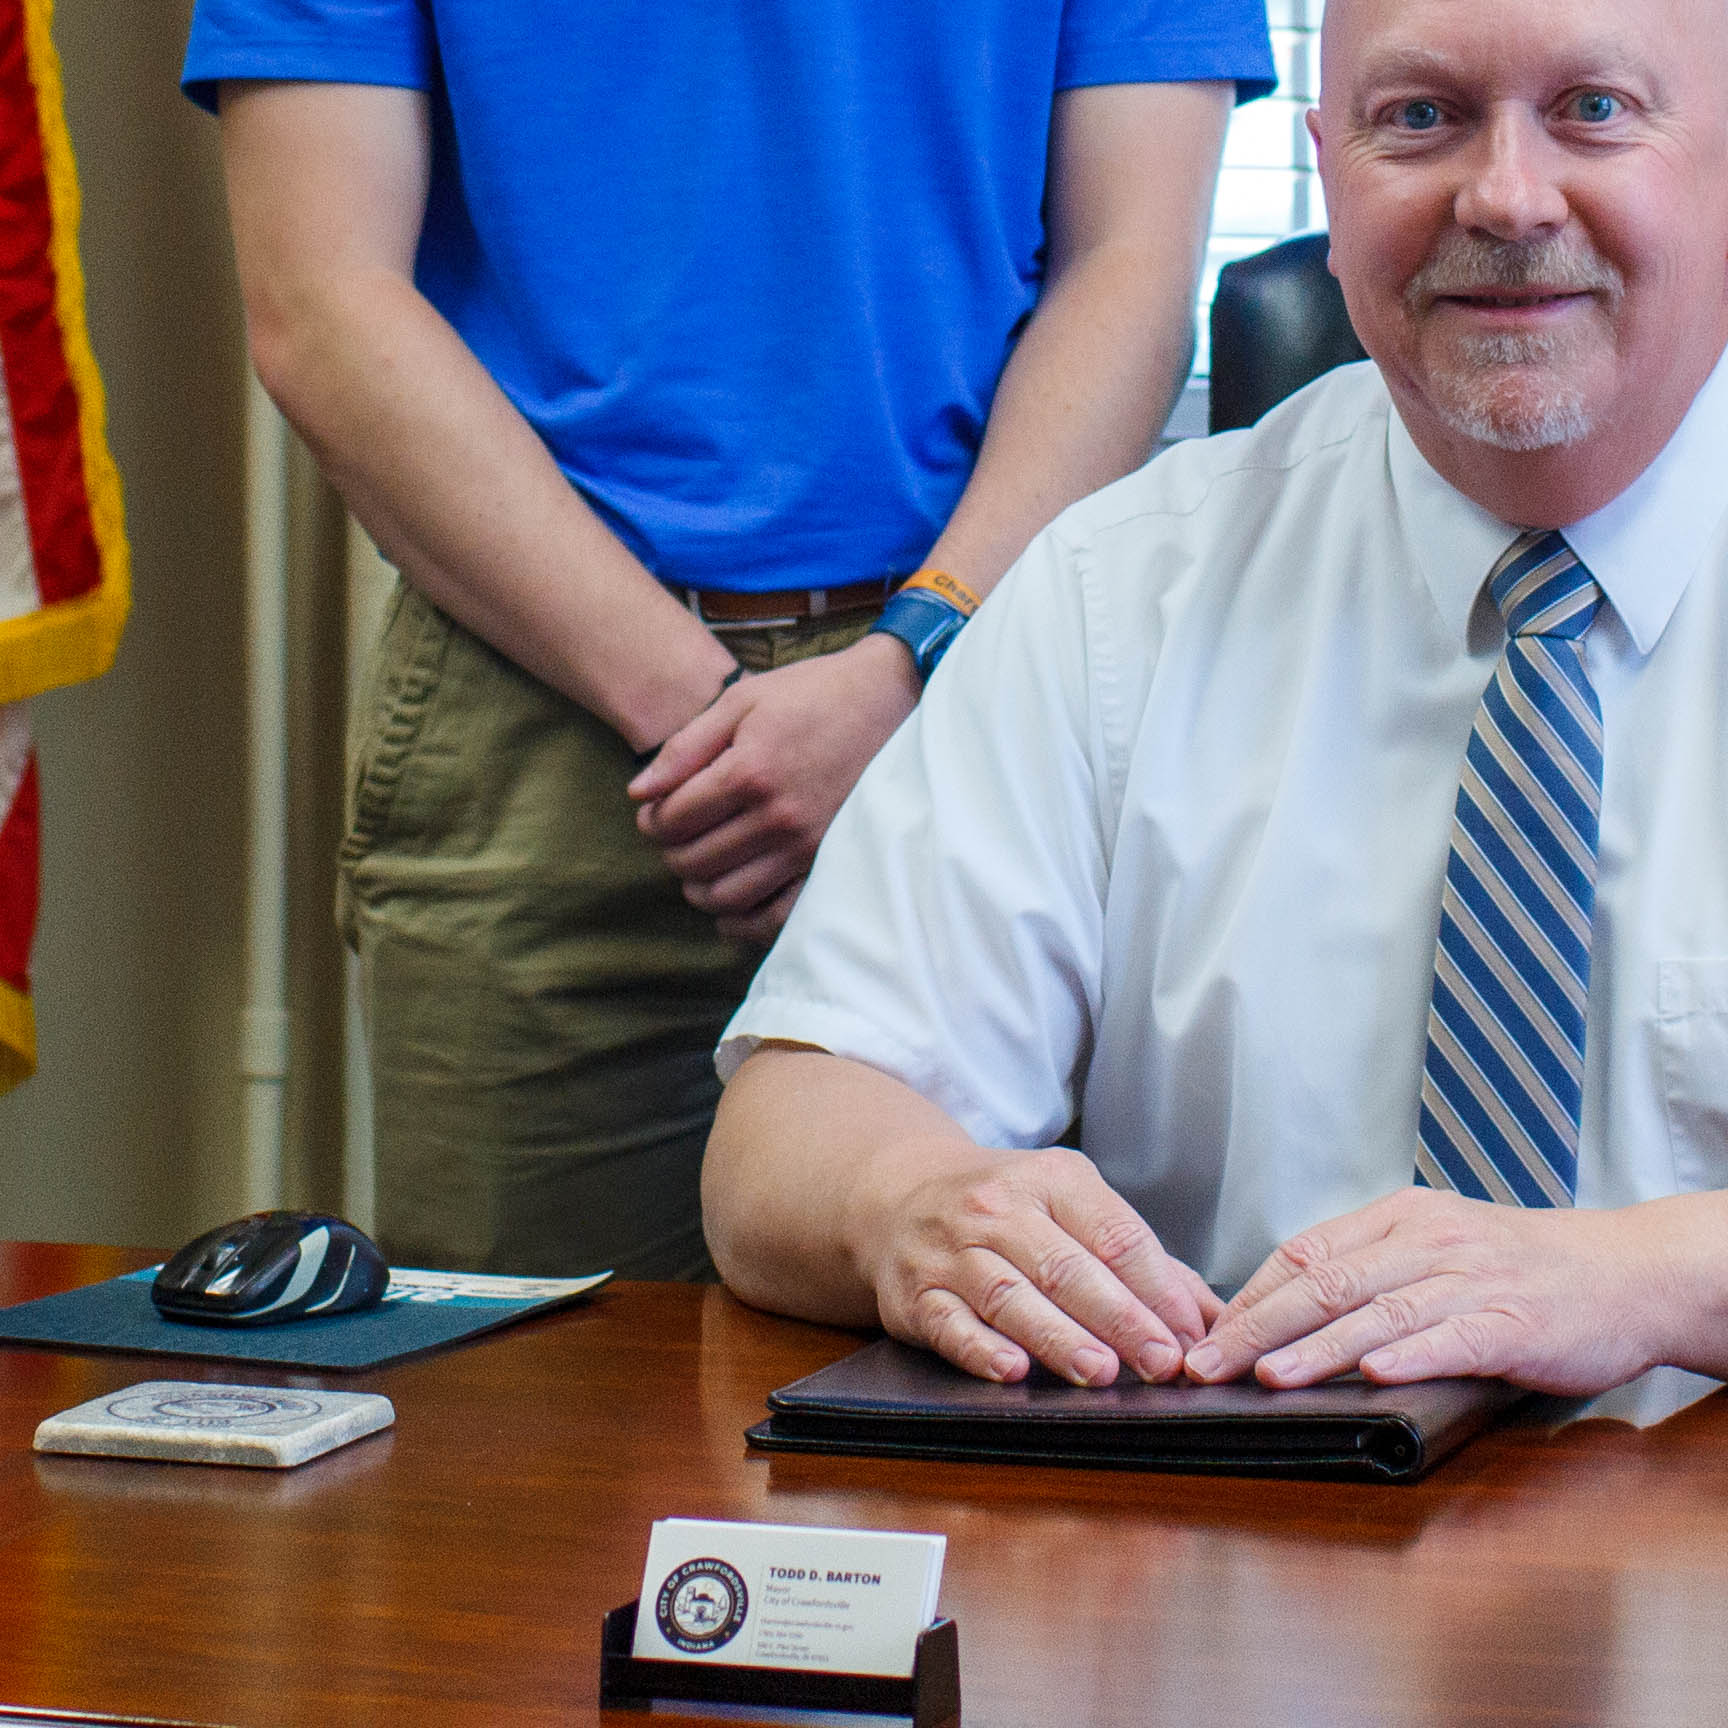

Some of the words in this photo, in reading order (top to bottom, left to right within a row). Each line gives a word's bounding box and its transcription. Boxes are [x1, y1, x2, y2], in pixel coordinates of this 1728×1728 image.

[769, 1567, 806, 1580] TODD
[809, 1569, 822, 1582] D.
[826, 1570, 882, 1585] BARTON
[659, 1590, 671, 1618] CITY
[667, 1573, 679, 1590] OF
